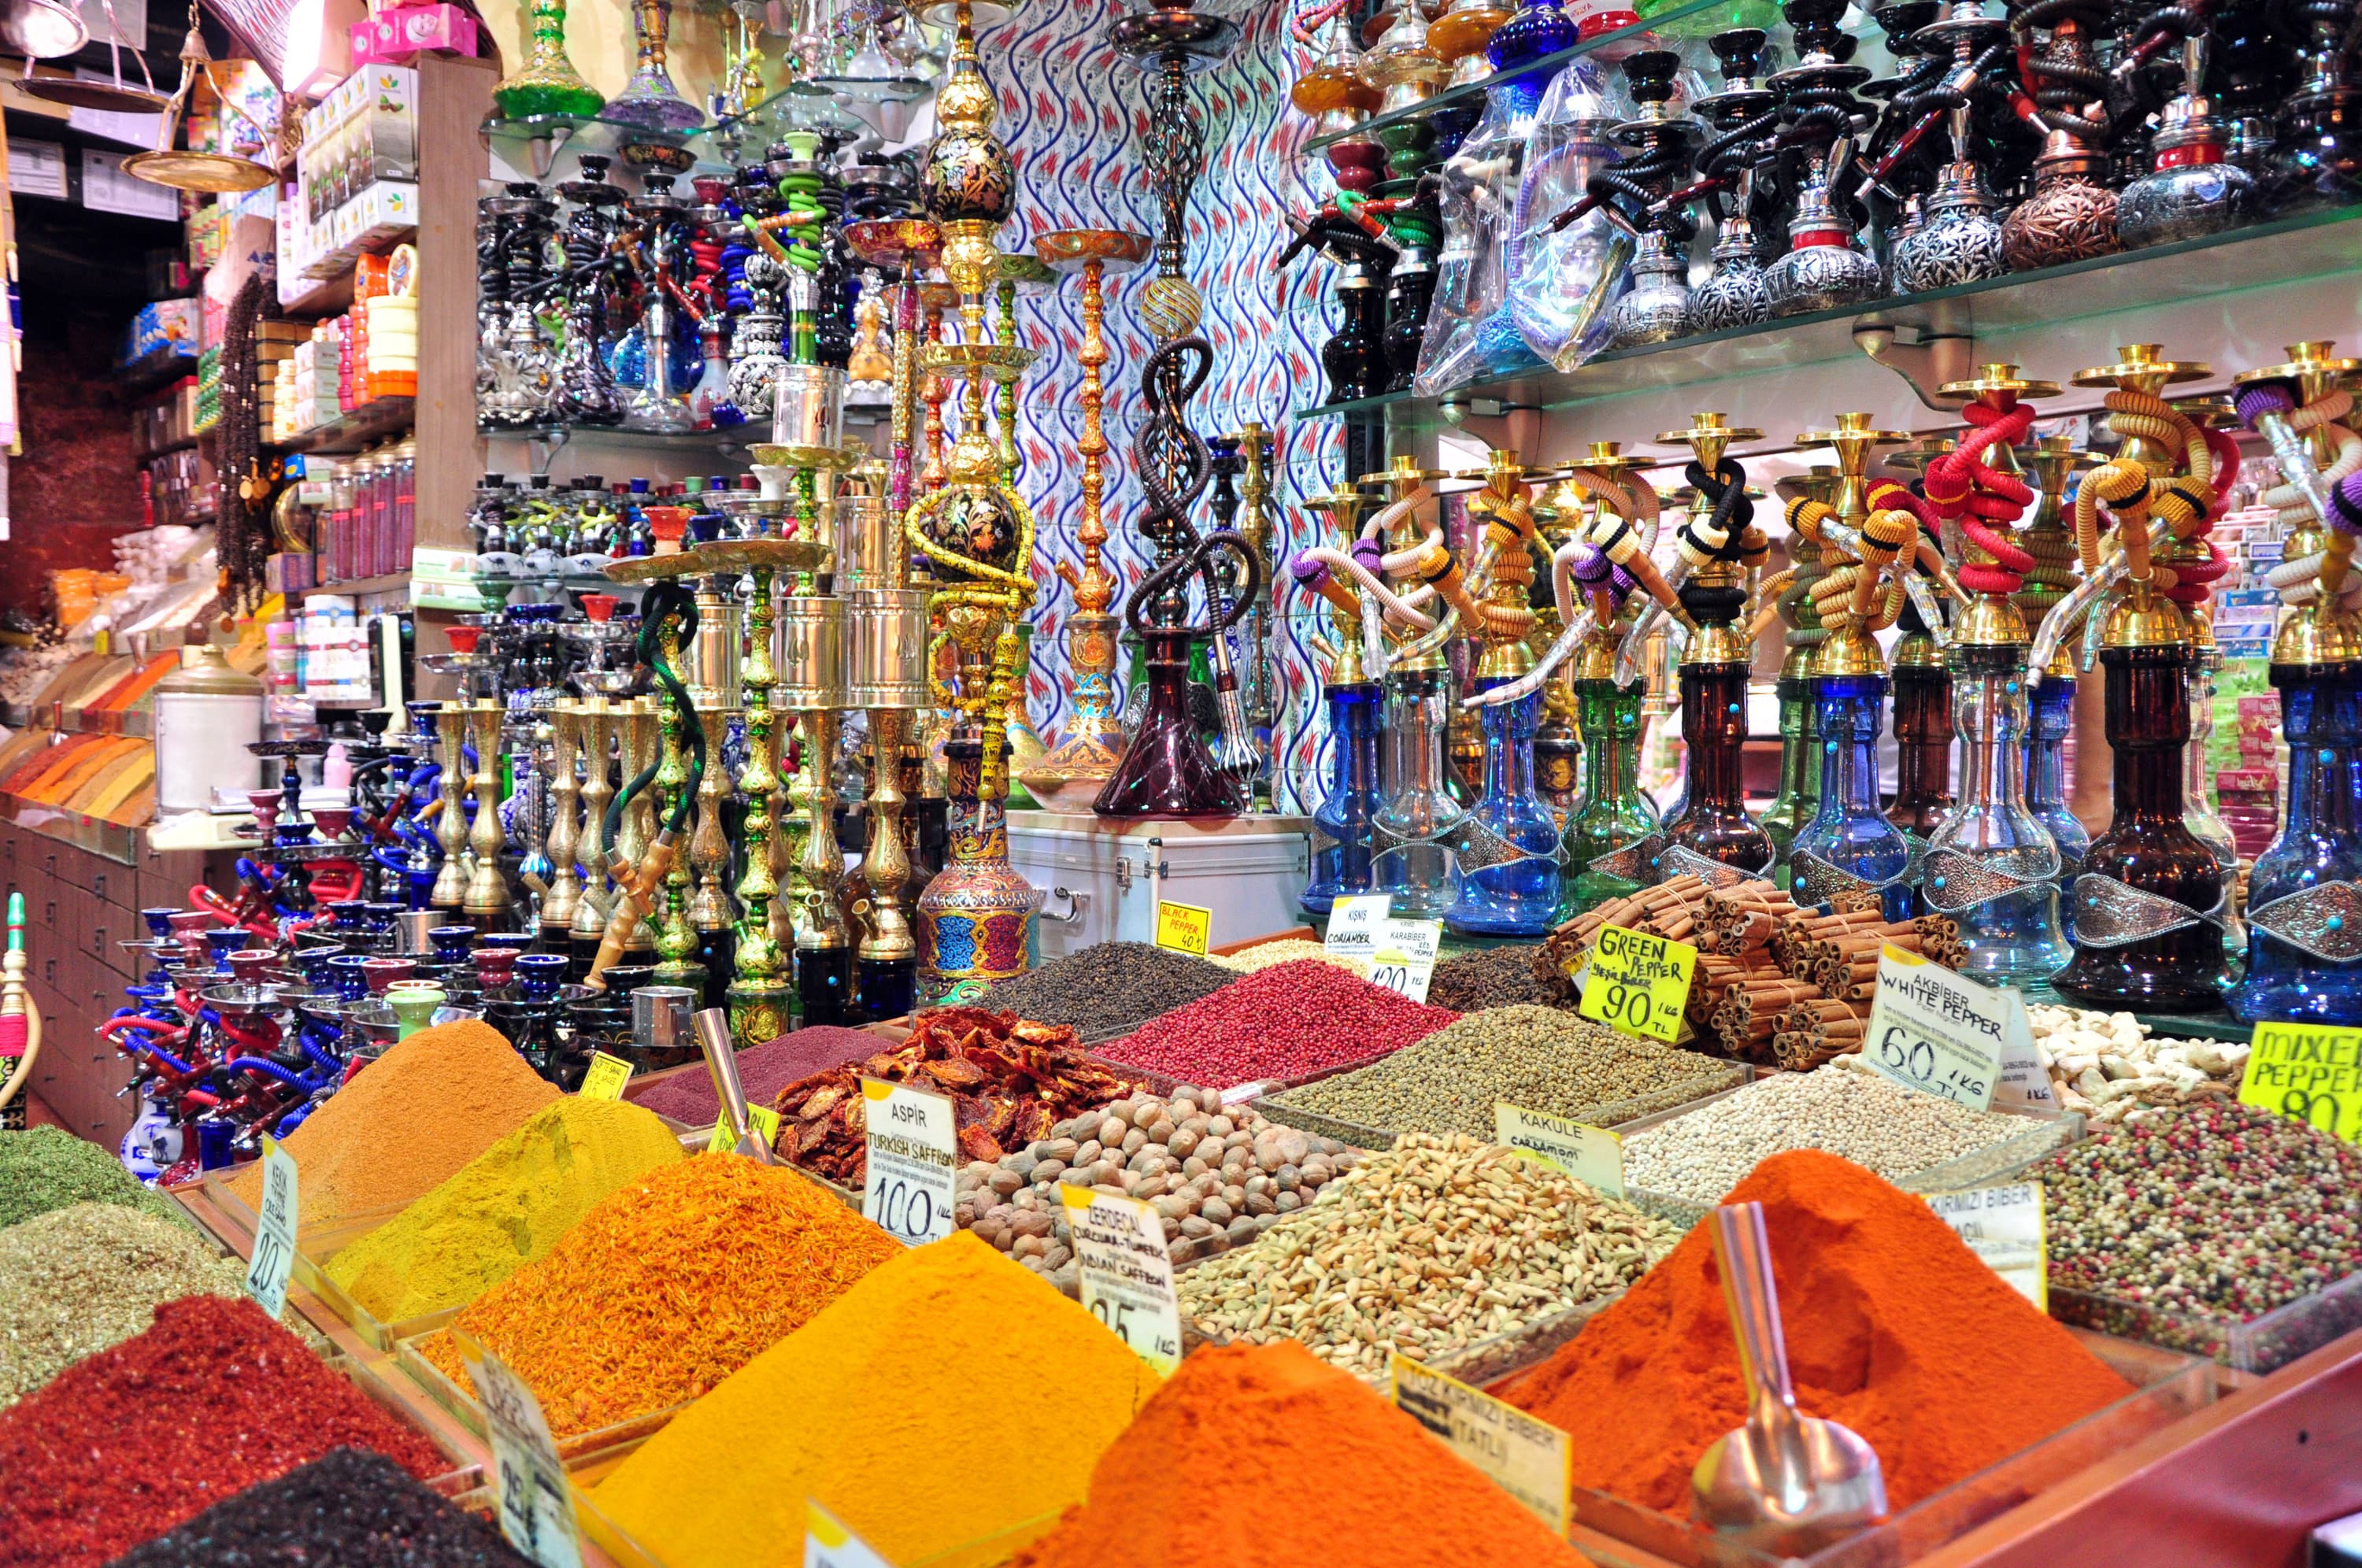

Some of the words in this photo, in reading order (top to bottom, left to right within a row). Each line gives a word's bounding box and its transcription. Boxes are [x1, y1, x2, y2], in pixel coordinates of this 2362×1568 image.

[1161, 905, 1189, 920] BLACK
[1169, 919, 1198, 935] PEPPER
[1182, 934, 1194, 947] 40
[1327, 932, 1370, 945] CORIANDER
[1390, 930, 1427, 942] KARABİBER
[1600, 928, 1667, 965] GREEN
[1630, 956, 1683, 982] PEPPER
[1601, 985, 1651, 1028] 90
[1879, 971, 1937, 1008] WHITE
[1942, 999, 2003, 1042] PEPPER
[1913, 973, 1970, 1009] AKBİBER
[1652, 1021, 1669, 1034] TL
[1881, 1026, 1935, 1082] 60
[891, 1102, 927, 1128] ASPİR
[1520, 1111, 1583, 1140] KAKULE
[867, 1132, 909, 1157] TURKISH
[912, 1142, 955, 1167] SAFFRON
[873, 1177, 932, 1237] 100
[1086, 1204, 1145, 1237] ZERDEÇAL
[250, 1232, 279, 1291] 20
